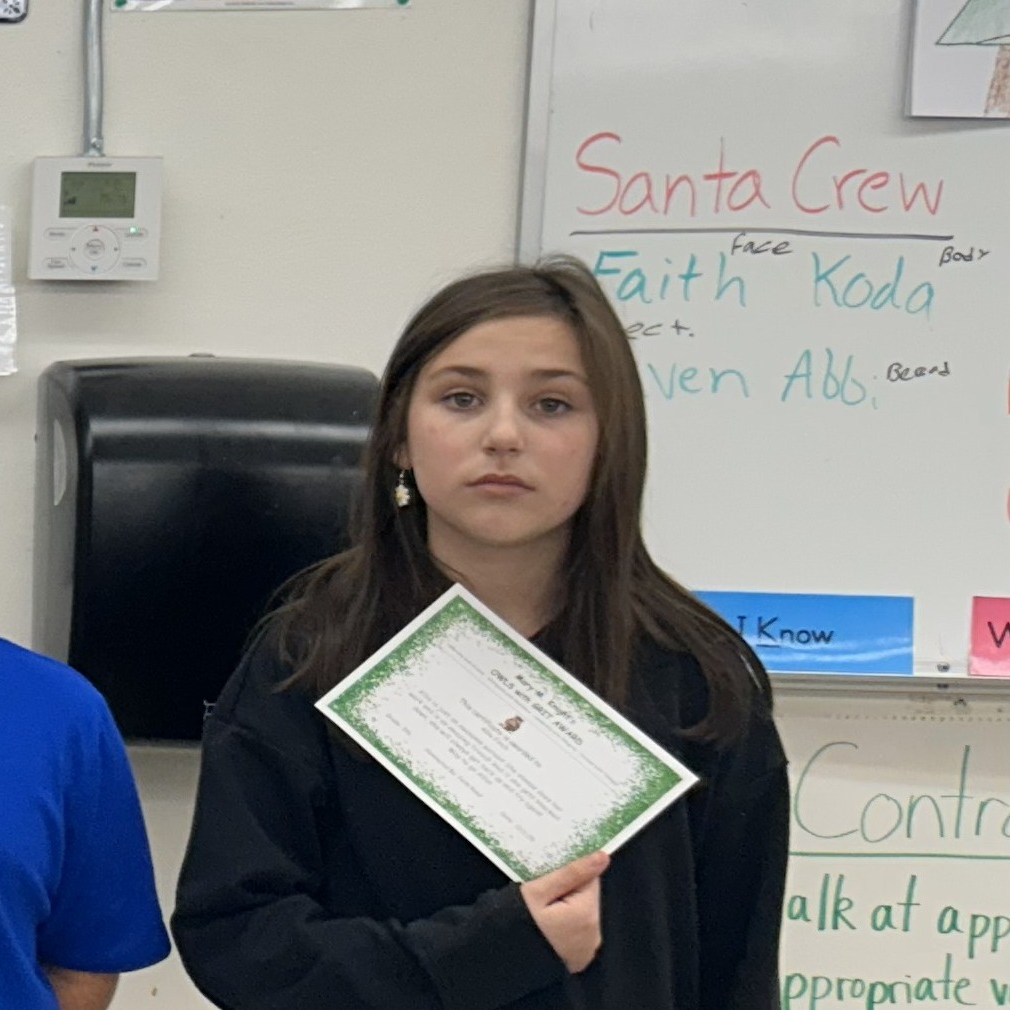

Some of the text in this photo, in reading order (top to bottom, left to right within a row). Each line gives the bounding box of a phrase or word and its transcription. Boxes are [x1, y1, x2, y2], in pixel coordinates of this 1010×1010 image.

[576, 132, 943, 216] Santa Crew
[593, 250, 935, 316] Faith Koda
[939, 246, 990, 267] Body
[757, 616, 834, 645] Know
[491, 668, 513, 690] OWLS
[553, 721, 584, 746] AWARD
[871, 875, 920, 932] at
[989, 978, 1010, 1006] v
